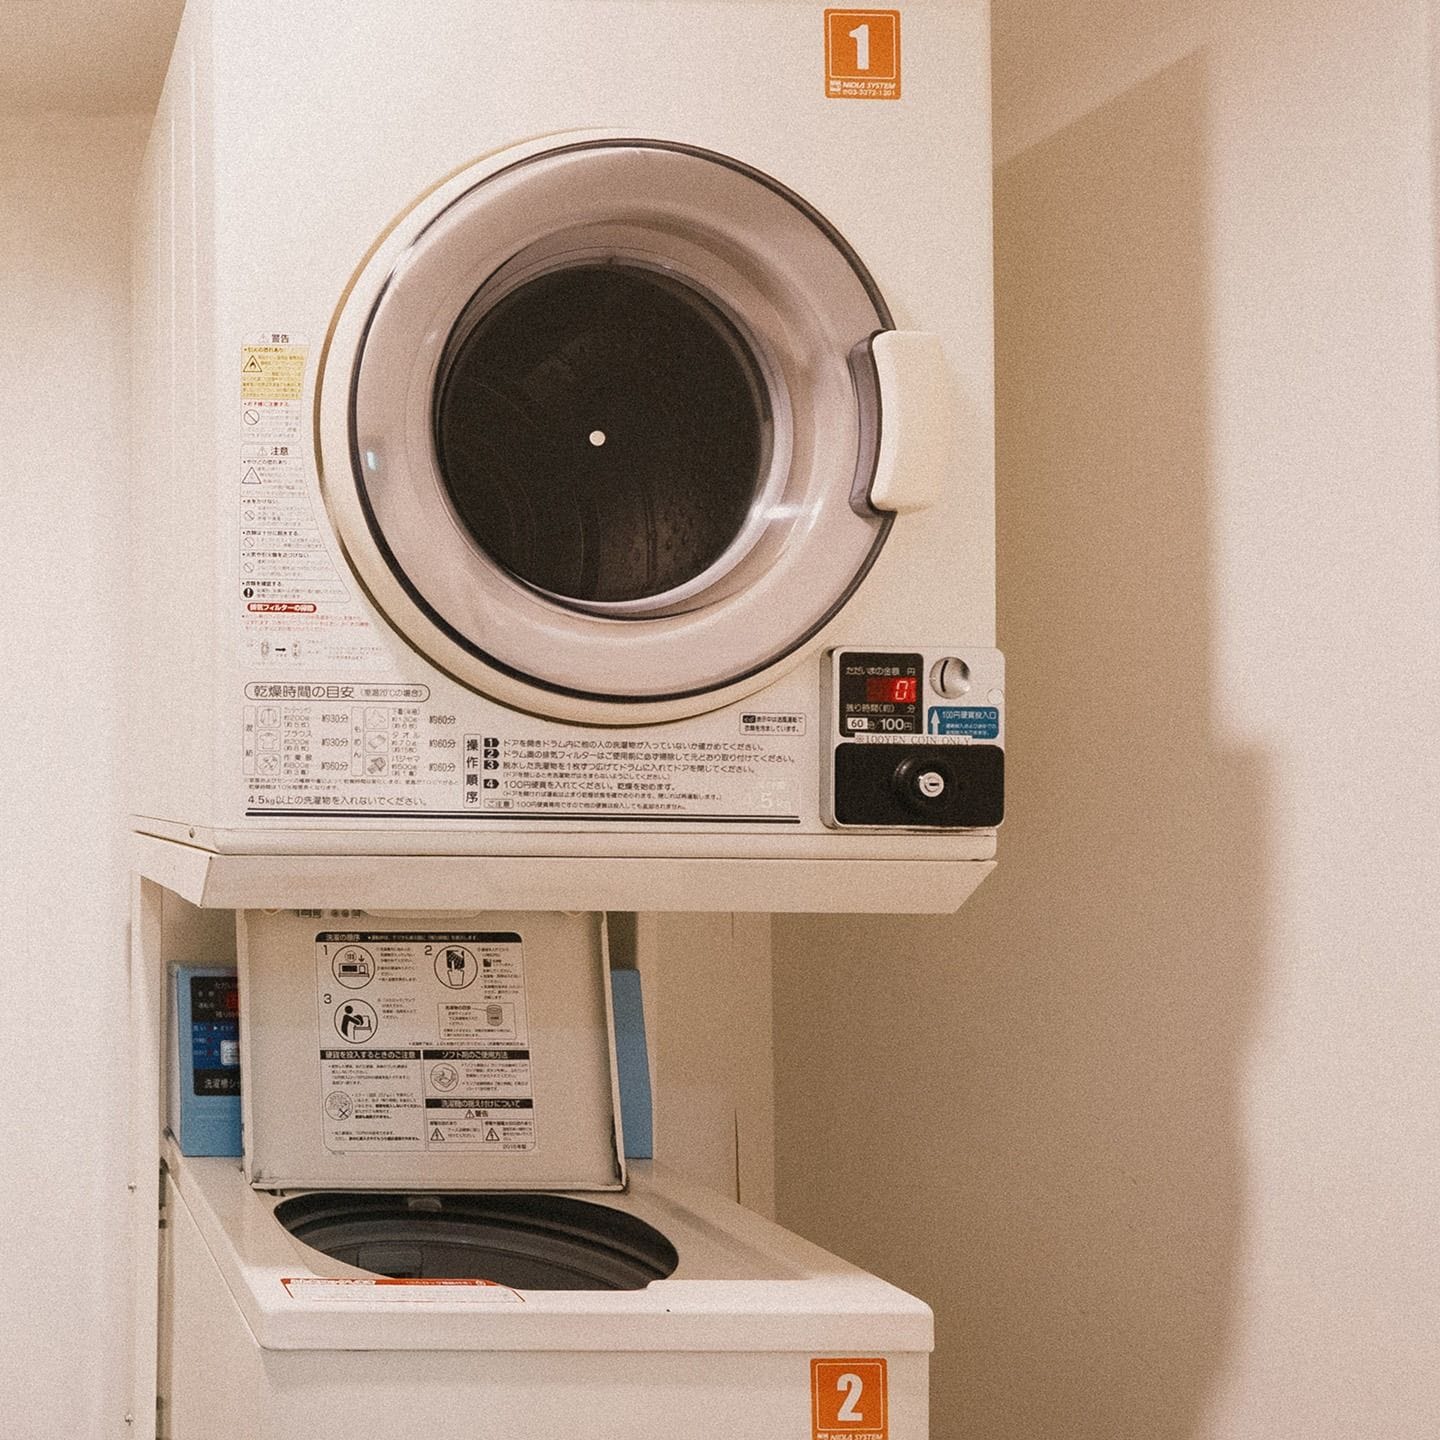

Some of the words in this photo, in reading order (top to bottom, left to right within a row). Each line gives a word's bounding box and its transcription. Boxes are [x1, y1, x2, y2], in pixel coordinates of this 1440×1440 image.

[849, 24, 870, 70] 1
[271, 334, 290, 343] 警告
[270, 447, 289, 456] 注意
[846, 667, 900, 675] ただいまの金額
[907, 667, 915, 675] 円
[254, 685, 355, 699] 乾燥時間の目安
[907, 704, 915, 713] 分
[911, 735, 937, 744] COIN
[942, 736, 970, 745] ONLY
[466, 739, 479, 803] 操作順序
[323, 945, 328, 955] 1
[424, 945, 432, 955] 2
[323, 993, 332, 1004] 3
[837, 1373, 863, 1421] 2
